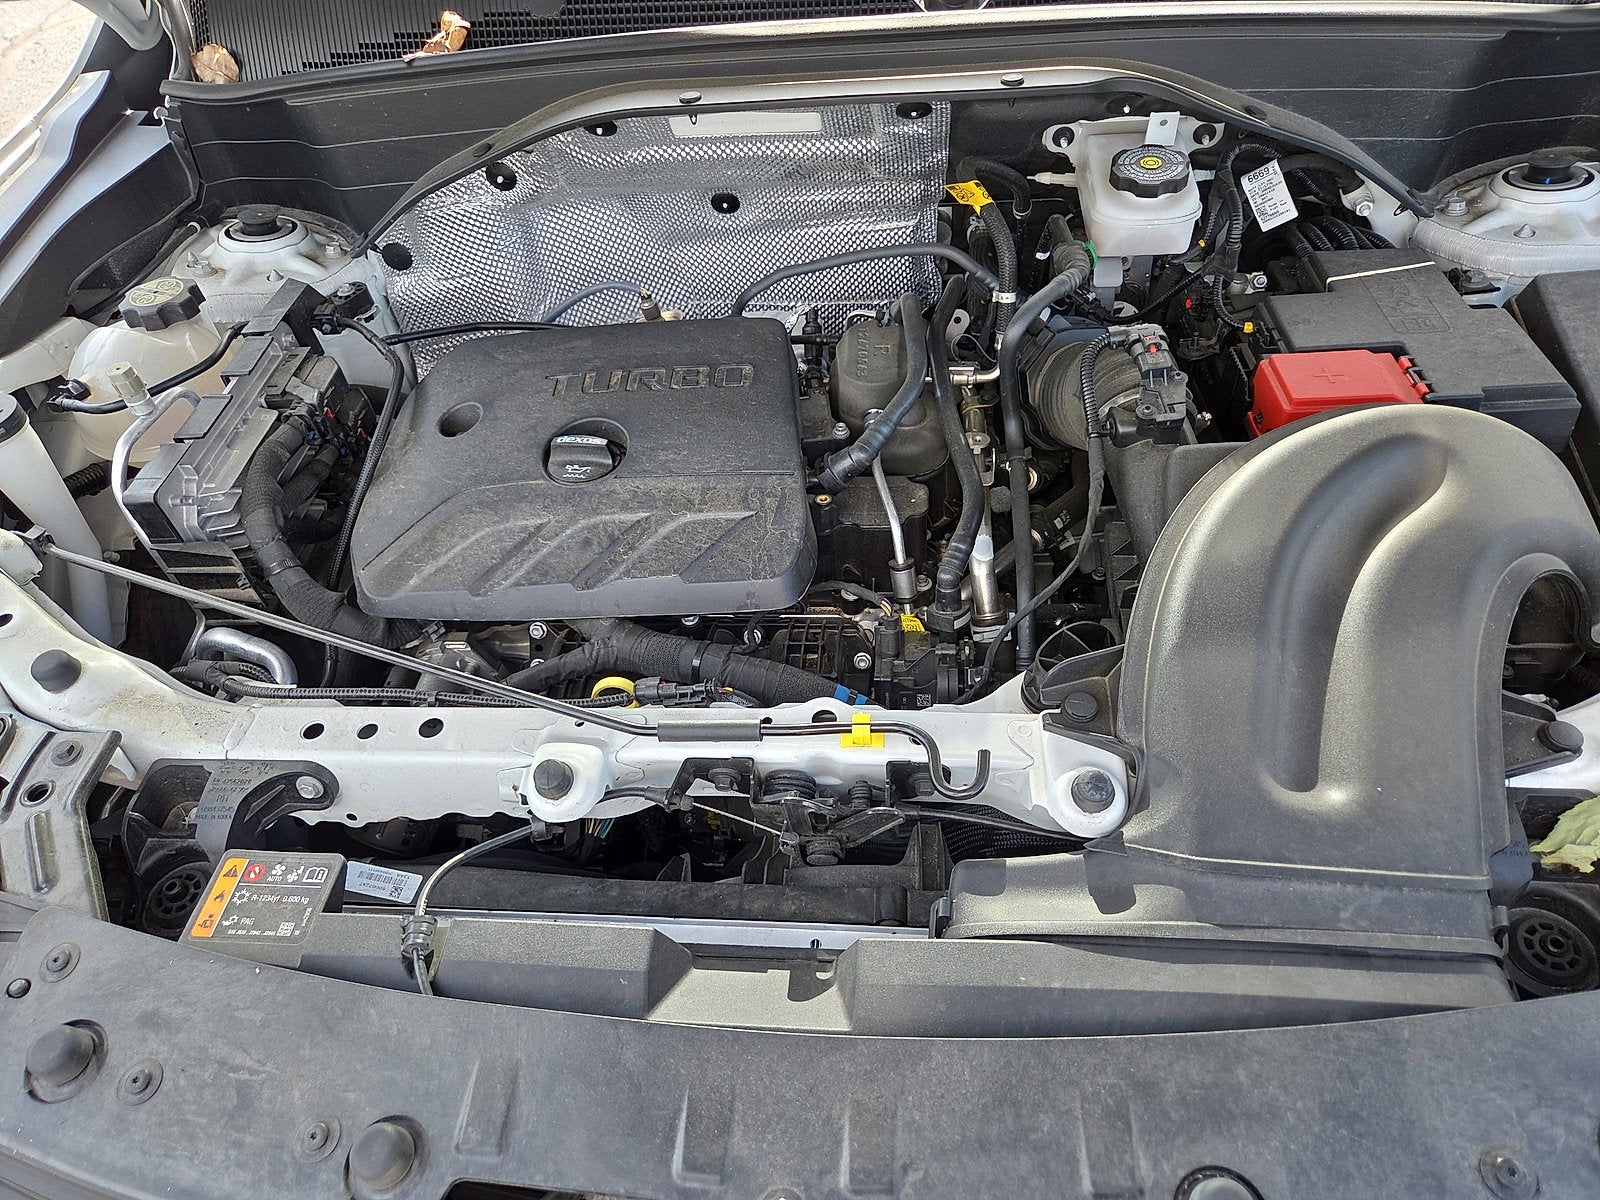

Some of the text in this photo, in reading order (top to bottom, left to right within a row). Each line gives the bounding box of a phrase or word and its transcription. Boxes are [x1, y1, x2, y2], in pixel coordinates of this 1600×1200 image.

[1247, 166, 1270, 183] 6669
[545, 363, 754, 397] TURBO
[555, 435, 601, 444] dexos
[251, 894, 310, 904] R-1234yf 0.600 kg
[239, 917, 255, 925] PAG
